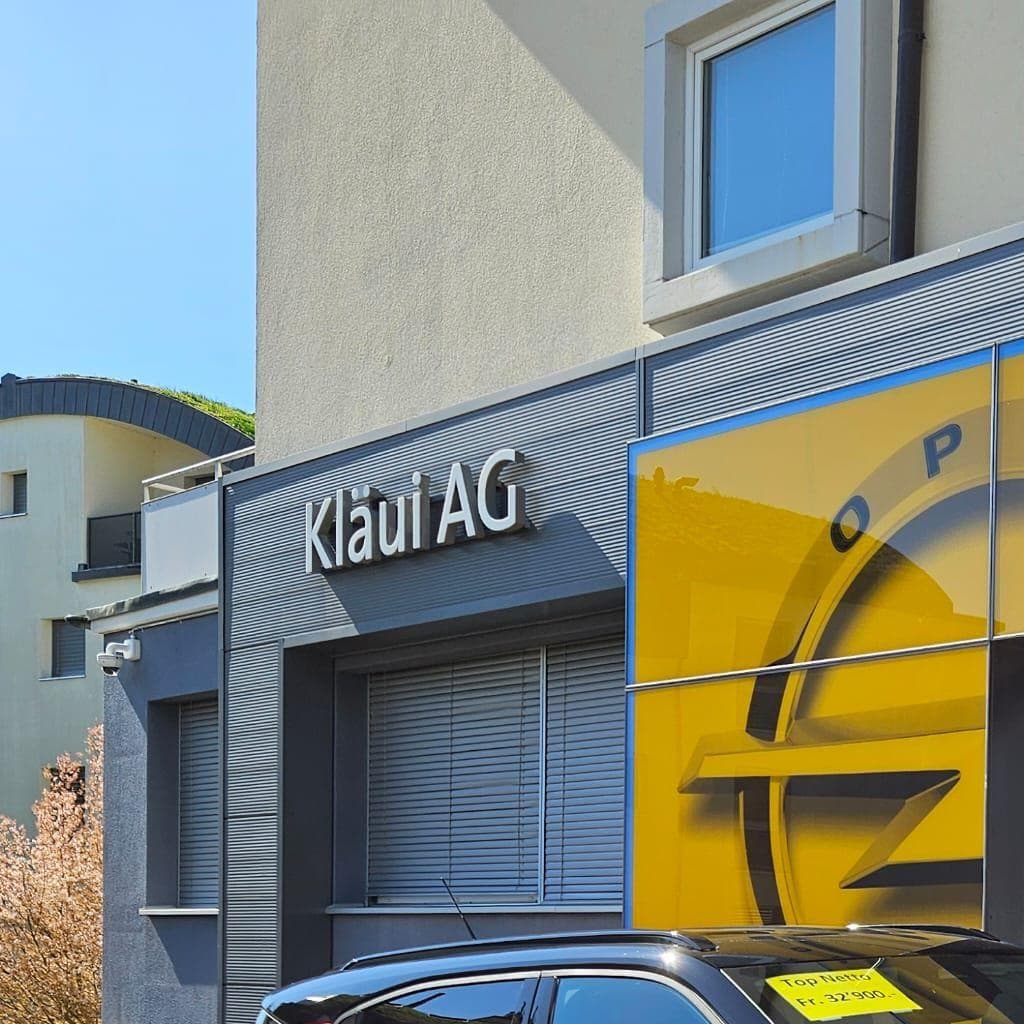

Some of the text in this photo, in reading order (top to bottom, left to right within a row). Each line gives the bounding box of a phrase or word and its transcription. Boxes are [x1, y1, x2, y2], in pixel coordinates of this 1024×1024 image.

[306, 448, 520, 574] Kläui AG
[780, 973, 872, 987] Top Netto
[796, 990, 897, 1007] Fr. 32'900.-
